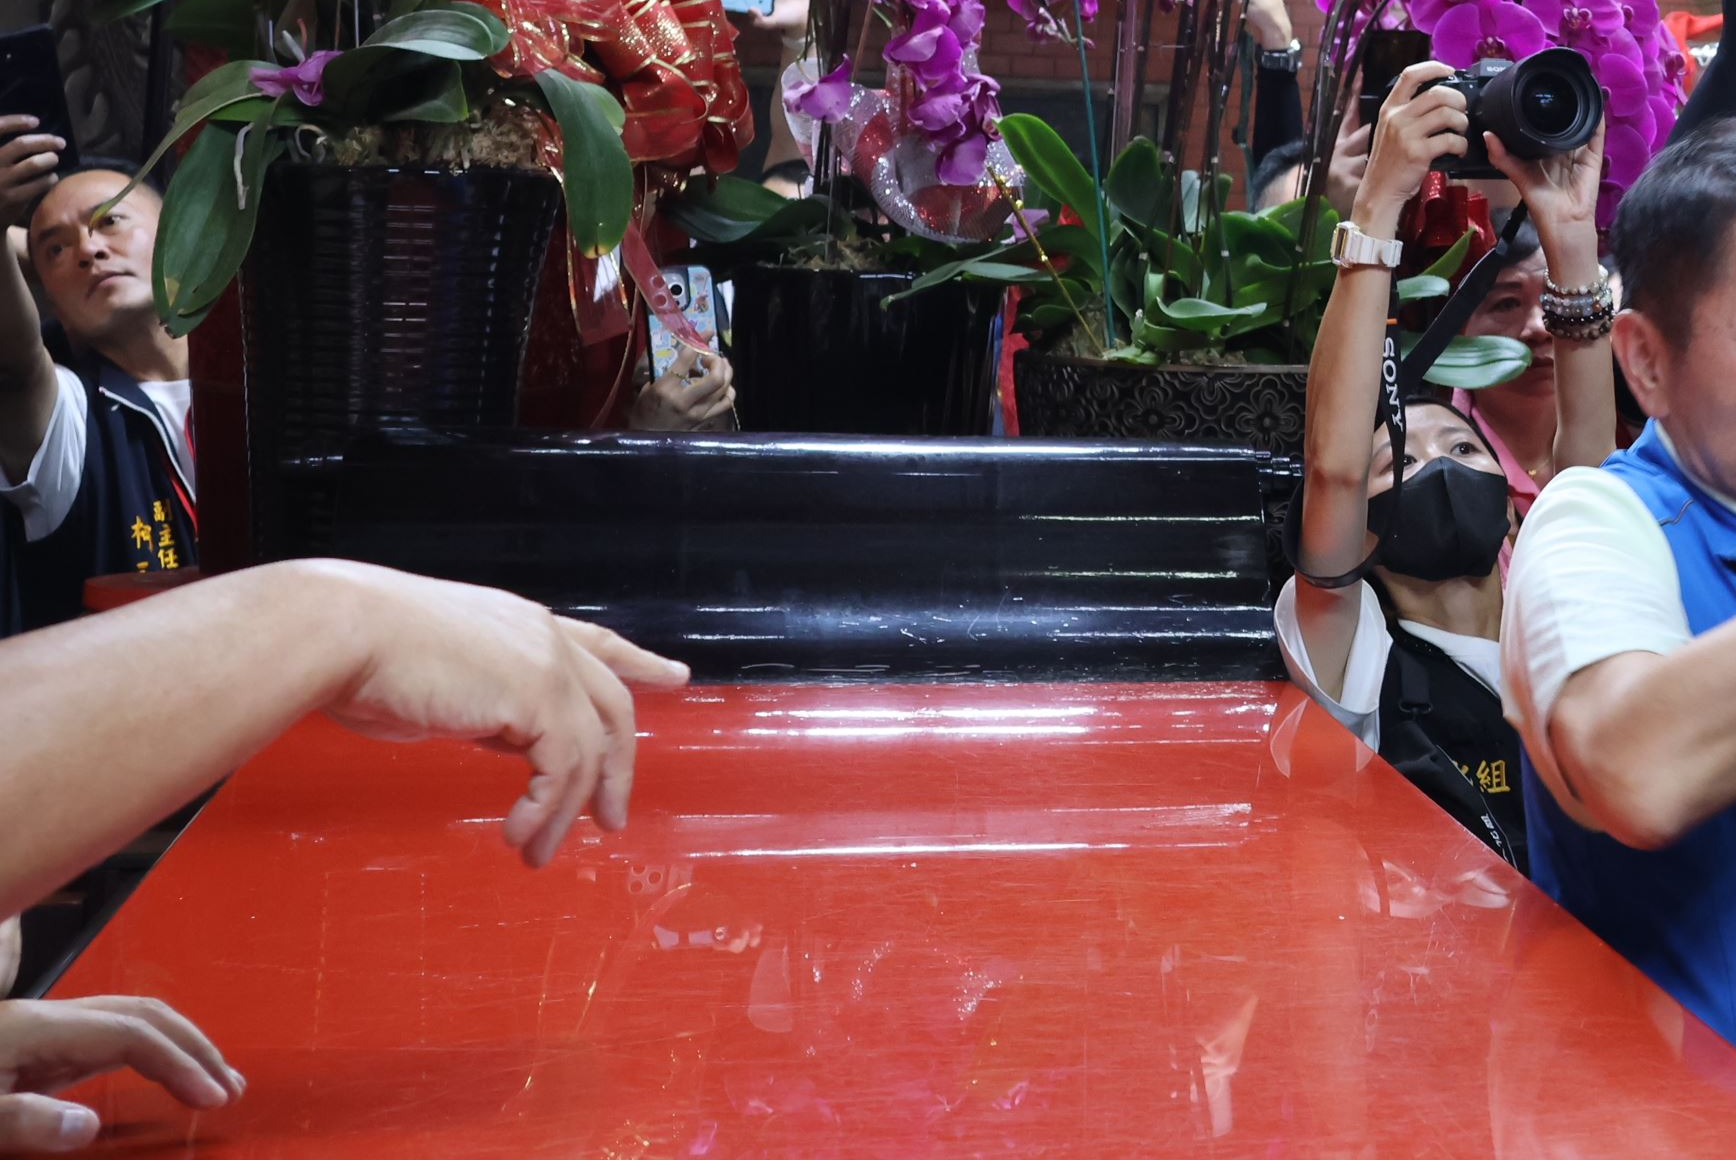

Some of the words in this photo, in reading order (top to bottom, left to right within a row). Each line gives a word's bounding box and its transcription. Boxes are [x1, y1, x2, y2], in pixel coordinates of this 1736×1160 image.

[1383, 337, 1404, 432] SONY
[131, 515, 154, 574] 柯
[153, 499, 179, 569] 副主任
